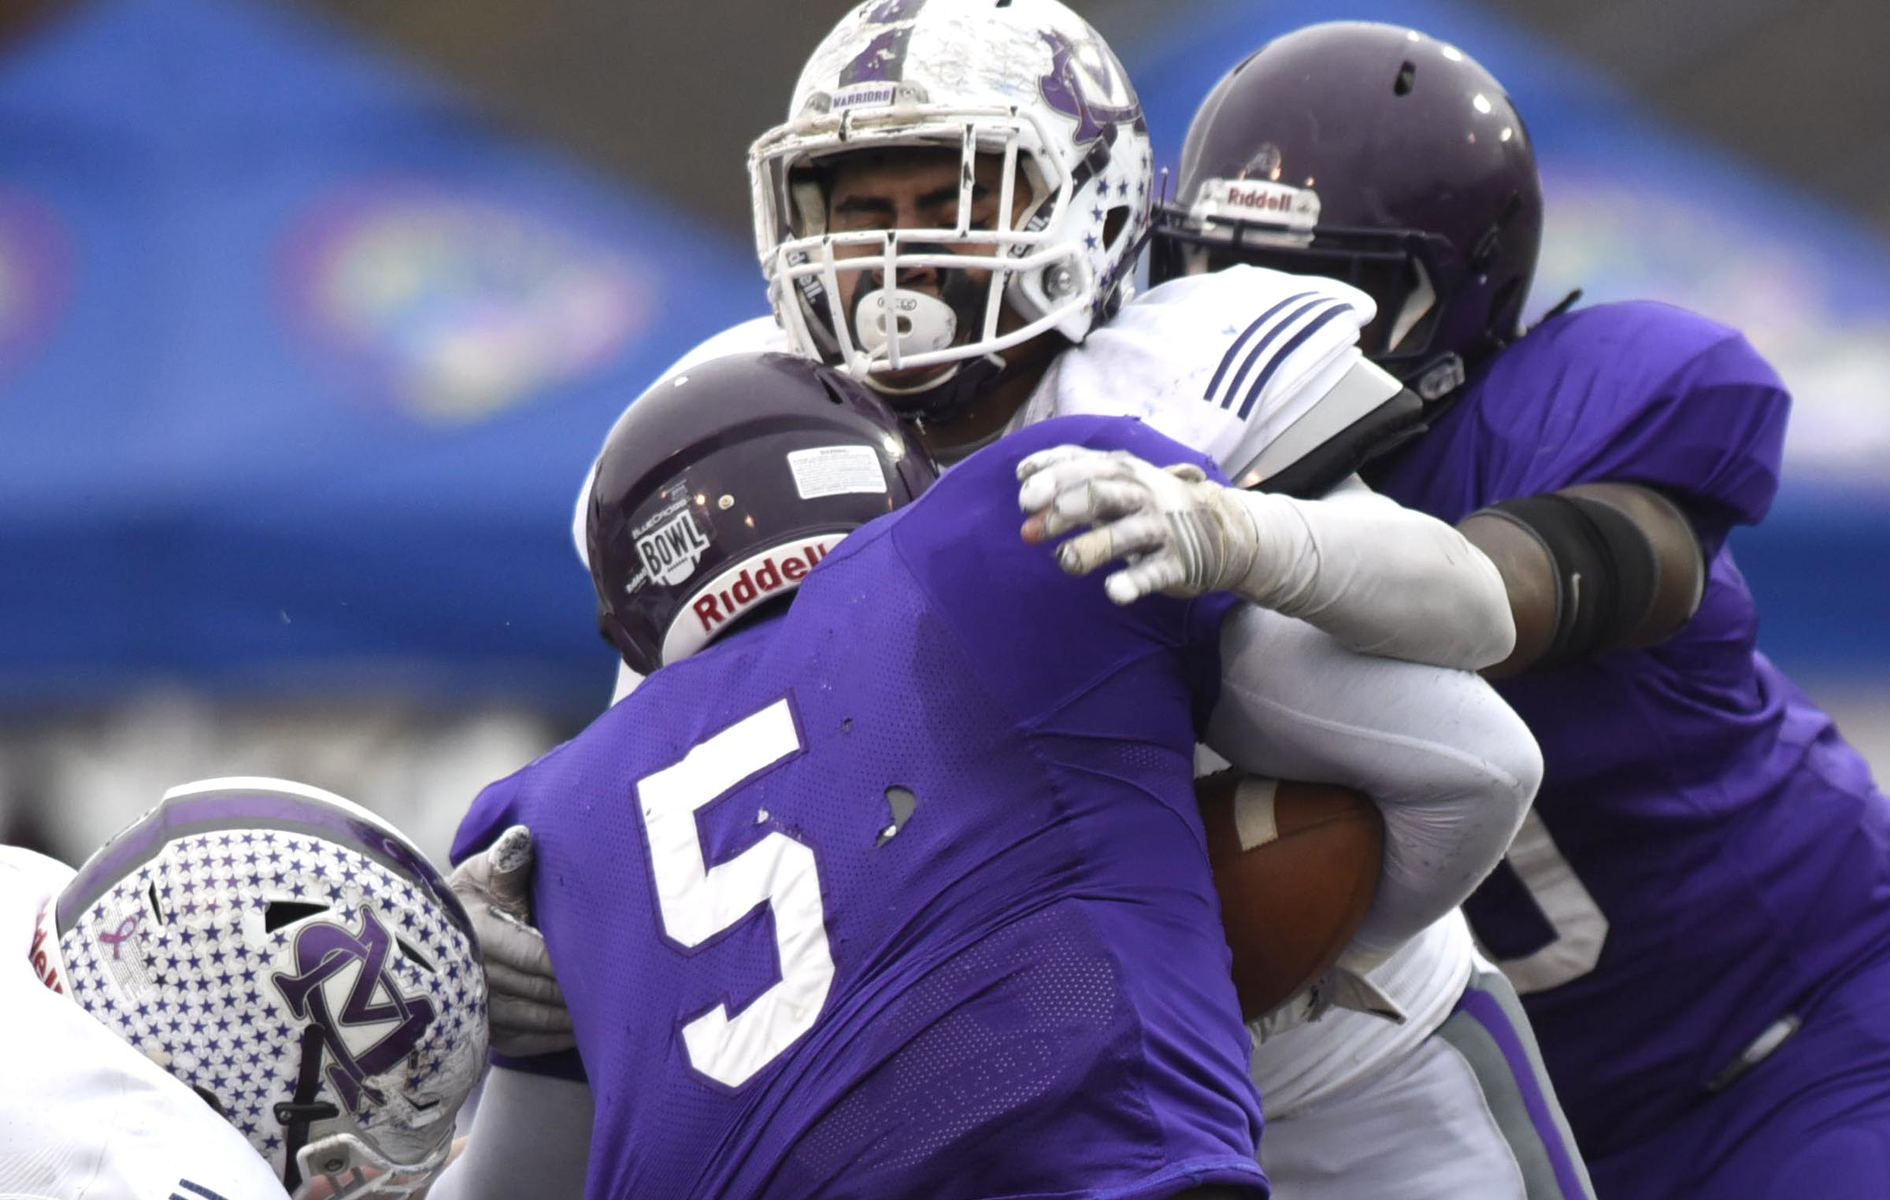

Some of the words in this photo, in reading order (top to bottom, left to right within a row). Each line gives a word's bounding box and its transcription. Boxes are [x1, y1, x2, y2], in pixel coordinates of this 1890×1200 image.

[833, 90, 891, 108] WARRIORS
[1228, 187, 1293, 212] Riddell
[641, 514, 705, 577] BOWL
[636, 698, 836, 1089] 5
